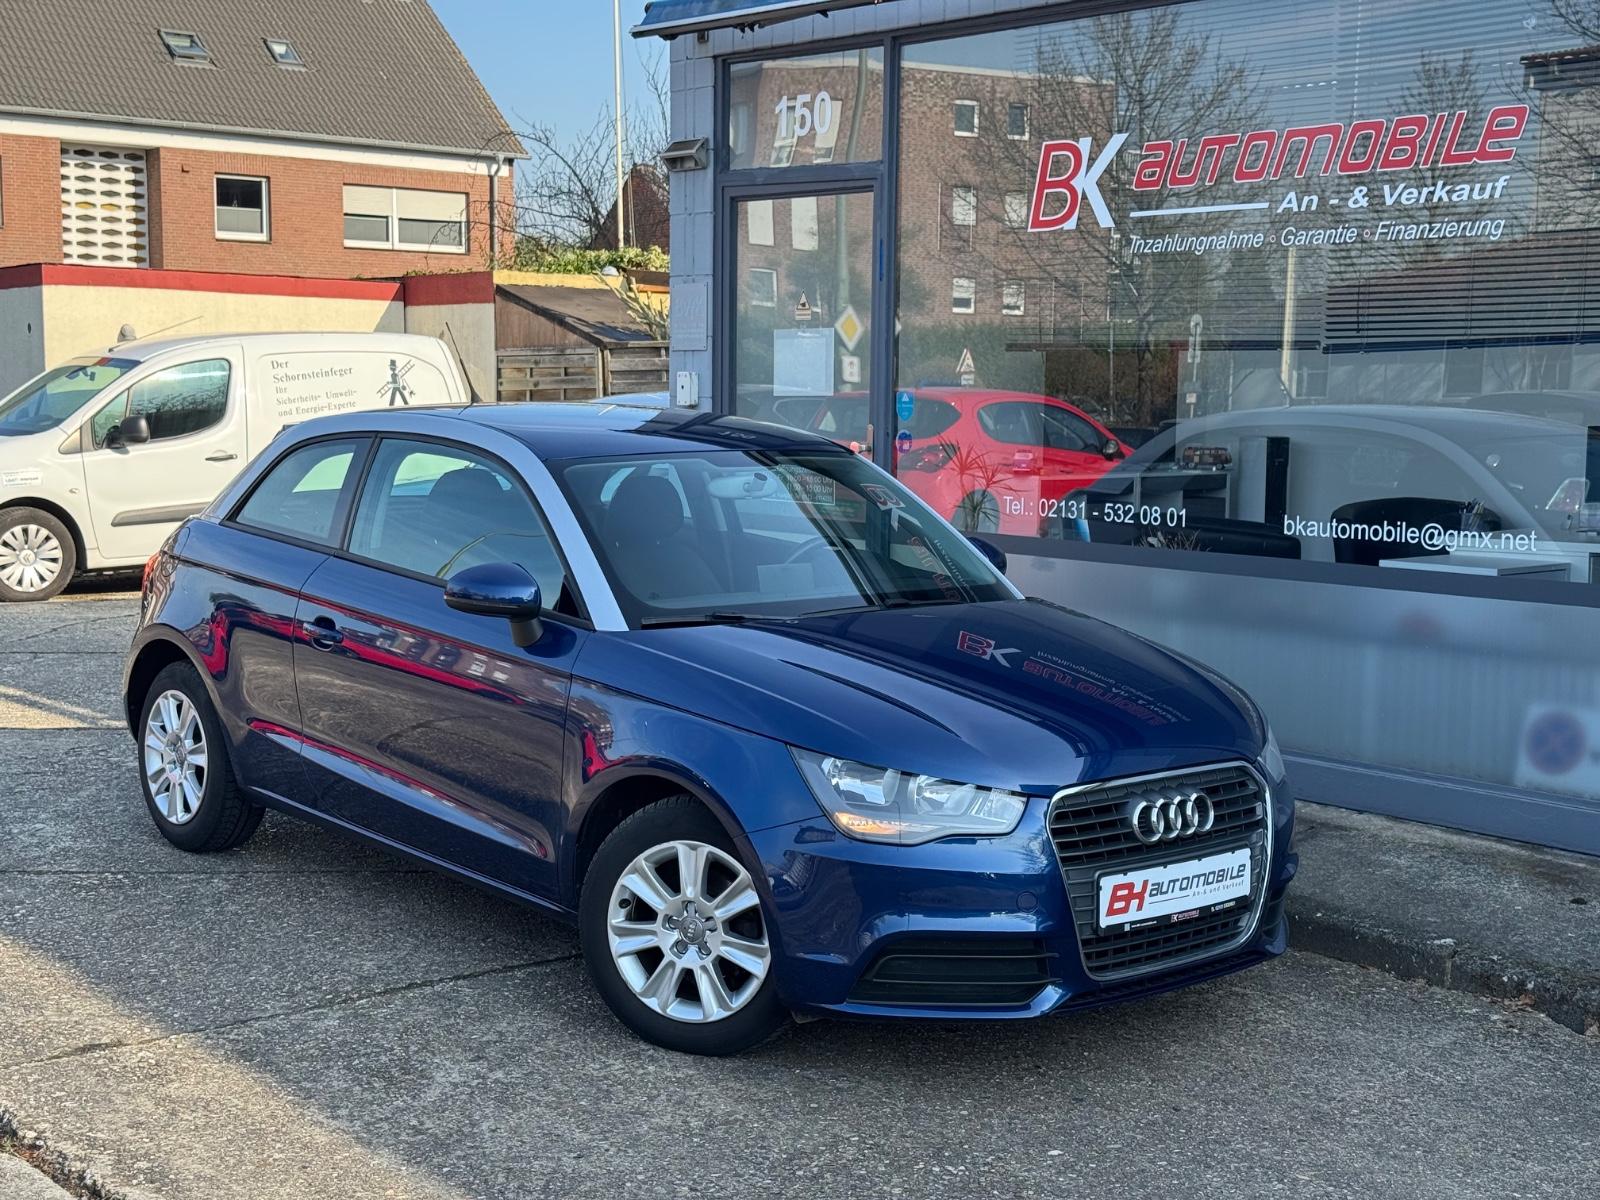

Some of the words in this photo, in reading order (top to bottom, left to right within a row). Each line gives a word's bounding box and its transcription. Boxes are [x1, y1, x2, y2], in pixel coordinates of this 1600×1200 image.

[774, 90, 832, 137] 150
[1027, 132, 1130, 232] BK
[1276, 191, 1319, 213] An
[1347, 185, 1370, 209] &
[1382, 175, 1511, 206] Verkauf
[1281, 223, 1358, 246] Garantie
[1374, 218, 1506, 241] Finanzierung
[271, 360, 289, 370] Der
[272, 367, 353, 384] Schornsteinfeger
[275, 386, 288, 394] Ihr
[278, 408, 293, 417] und
[1003, 496, 1033, 516] Tel.:
[1038, 498, 1087, 520] 02131
[1104, 502, 1135, 524] 532
[1139, 505, 1161, 526] 08
[1166, 507, 1187, 528] 01
[1283, 514, 1537, 552] bkautomobile@gmx.net
